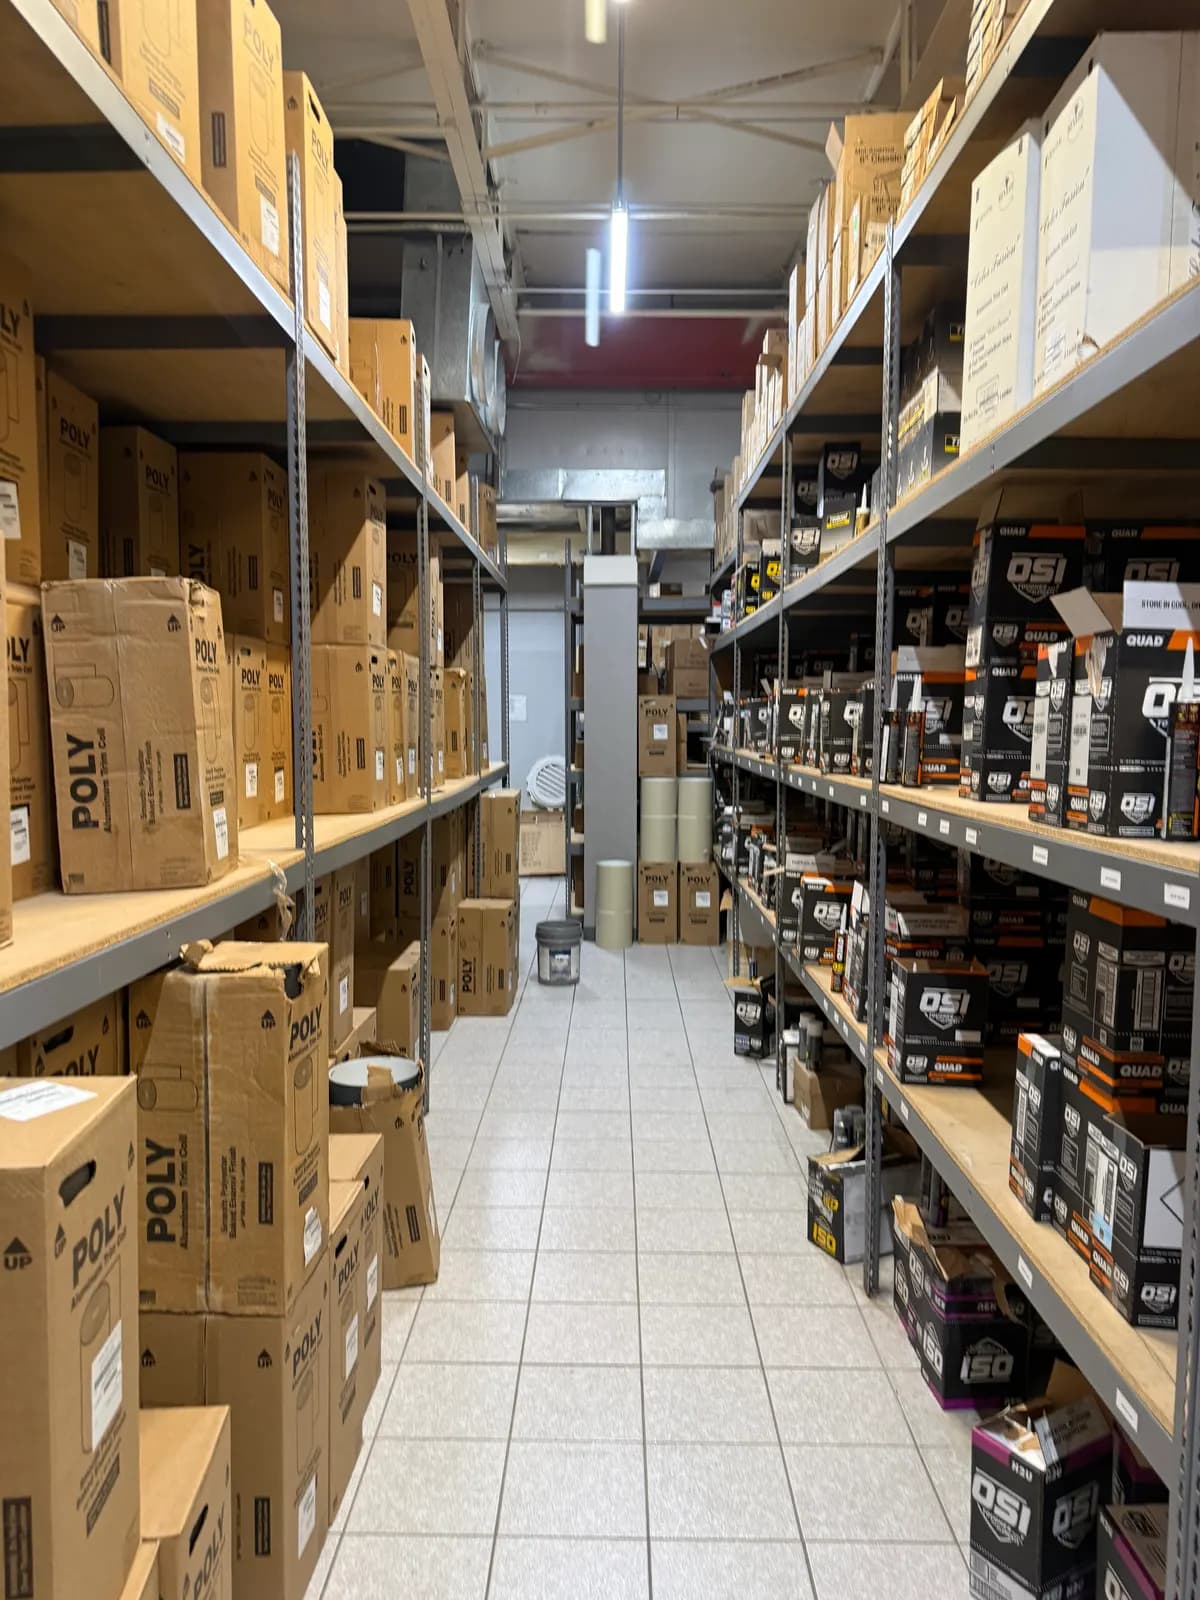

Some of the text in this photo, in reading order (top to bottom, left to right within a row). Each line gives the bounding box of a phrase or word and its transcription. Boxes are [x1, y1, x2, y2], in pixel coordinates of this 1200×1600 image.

[59, 416, 91, 450] POLY
[145, 465, 170, 491] POLY
[1000, 527, 1027, 537] QUAD
[1006, 553, 1069, 585] OSI
[1024, 631, 1058, 643] QUAD
[1126, 634, 1165, 648] QUAD
[195, 638, 217, 665] POLY
[241, 669, 261, 686] POLY
[269, 674, 285, 689] POLY
[992, 667, 1018, 678] QUAD
[1050, 679, 1065, 699] OSI
[645, 708, 668, 717] POLY
[924, 763, 947, 773] UAD
[66, 734, 99, 830] POLY
[987, 771, 1012, 789] OSI
[1030, 791, 1046, 803] QUAD
[1047, 783, 1060, 802] OSI
[1089, 791, 1107, 810] OSI
[1070, 797, 1088, 812] QUAD
[1120, 793, 1156, 815] OSI
[646, 875, 669, 885] POLY
[687, 876, 711, 886] POLY
[1073, 930, 1091, 956] OSI
[463, 960, 473, 993] POLY
[736, 1001, 762, 1020] OSI
[919, 987, 971, 1015] OSI
[289, 1003, 322, 1051] POLY
[1063, 1025, 1078, 1048] OSI
[51, 1044, 99, 1076] OLY
[906, 1055, 929, 1071] OSI
[1081, 1044, 1100, 1066] QUAD
[934, 1062, 963, 1073] QUAD
[1063, 1066, 1078, 1085] QUAD
[1119, 1064, 1162, 1078] QUAD
[1029, 1082, 1041, 1109] OSI
[1064, 1103, 1081, 1132] OSI
[1160, 1103, 1188, 1114] QUA
[1119, 1153, 1138, 1181] OSI
[146, 1138, 176, 1242] POLY
[1054, 1193, 1068, 1219] OSI
[72, 1186, 125, 1286] POLY
[1071, 1218, 1089, 1246] QUAD
[3, 1255, 33, 1271] UP
[338, 1240, 360, 1295] POLY
[1092, 1249, 1112, 1276] QUAD
[1113, 1264, 1129, 1294] OSI
[1140, 1282, 1177, 1304] OSI
[292, 1311, 322, 1377] POLY
[971, 1467, 1032, 1537] OSI
[1052, 1480, 1100, 1538] OSI
